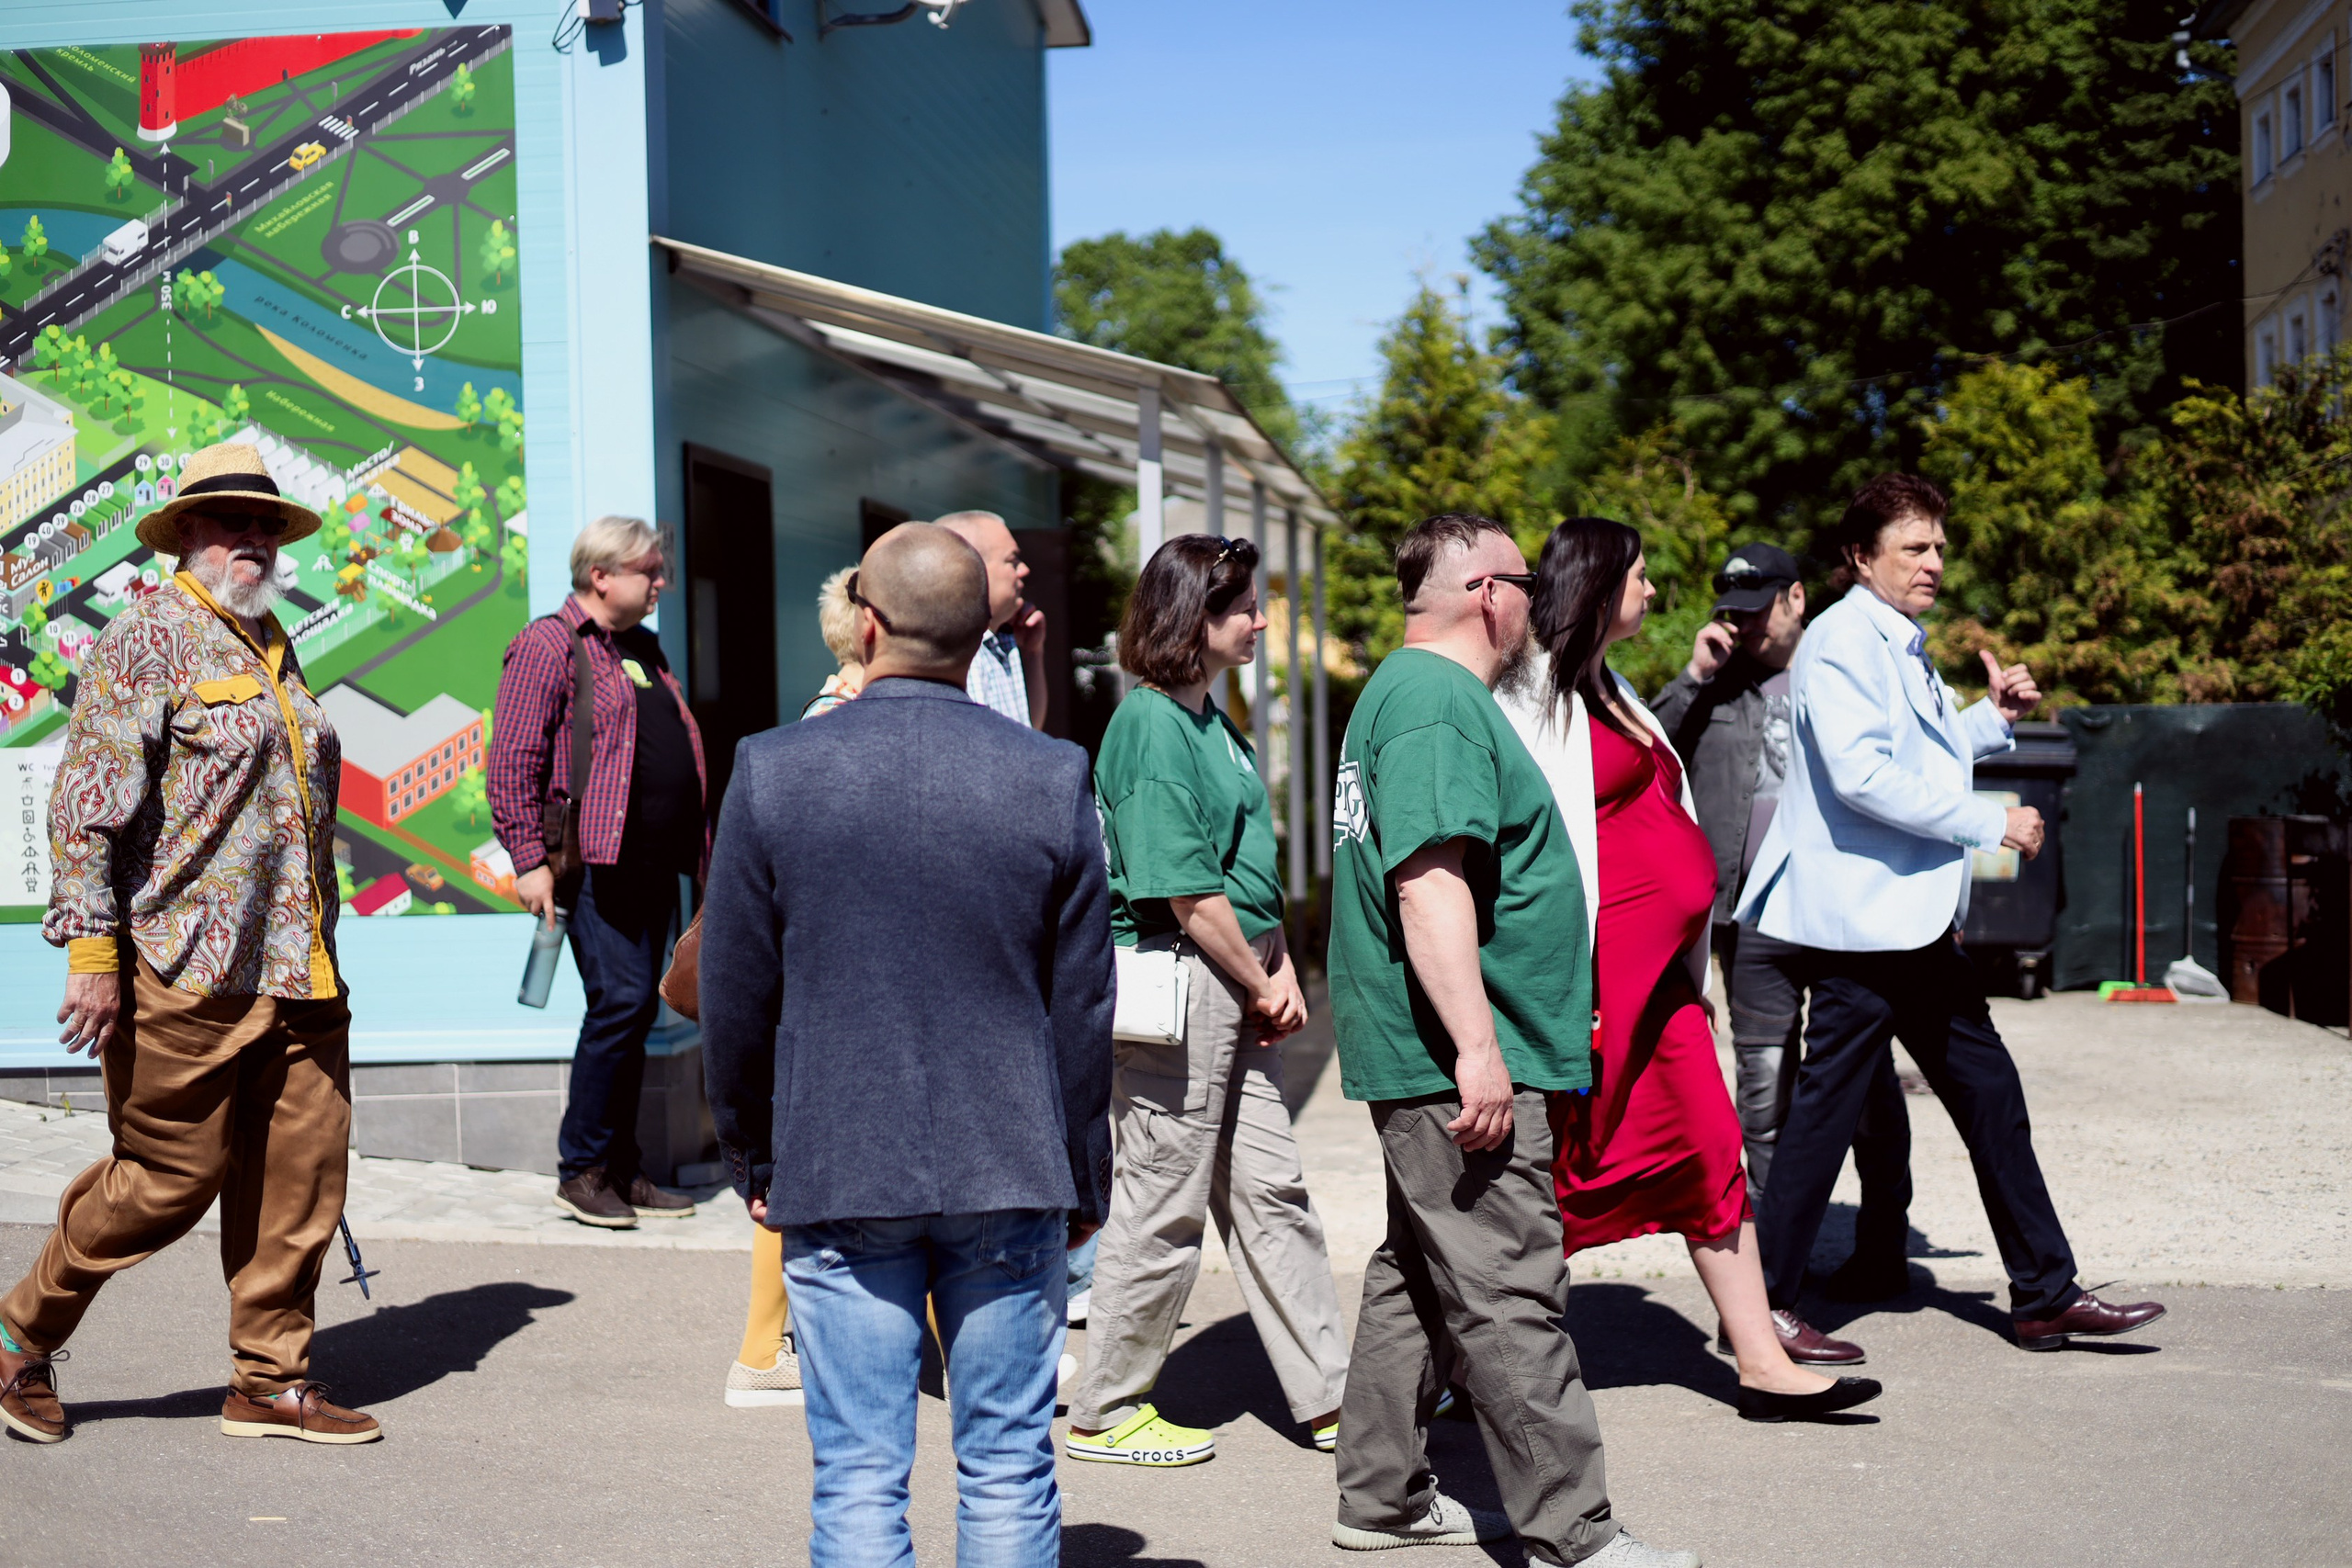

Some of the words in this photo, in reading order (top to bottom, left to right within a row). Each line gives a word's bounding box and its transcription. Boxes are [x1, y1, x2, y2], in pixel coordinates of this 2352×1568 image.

[409, 47, 447, 75] Рязань
[254, 181, 334, 233] Михайловская
[161, 284, 173, 311] 350
[253, 294, 288, 316] река
[291, 313, 369, 362] Коломенка
[266, 389, 336, 434] Набережная
[10, 551, 36, 575] Муз
[10, 557, 49, 588] Салон
[17, 762, 35, 773] WC
[1131, 1449, 1185, 1462] crocs
